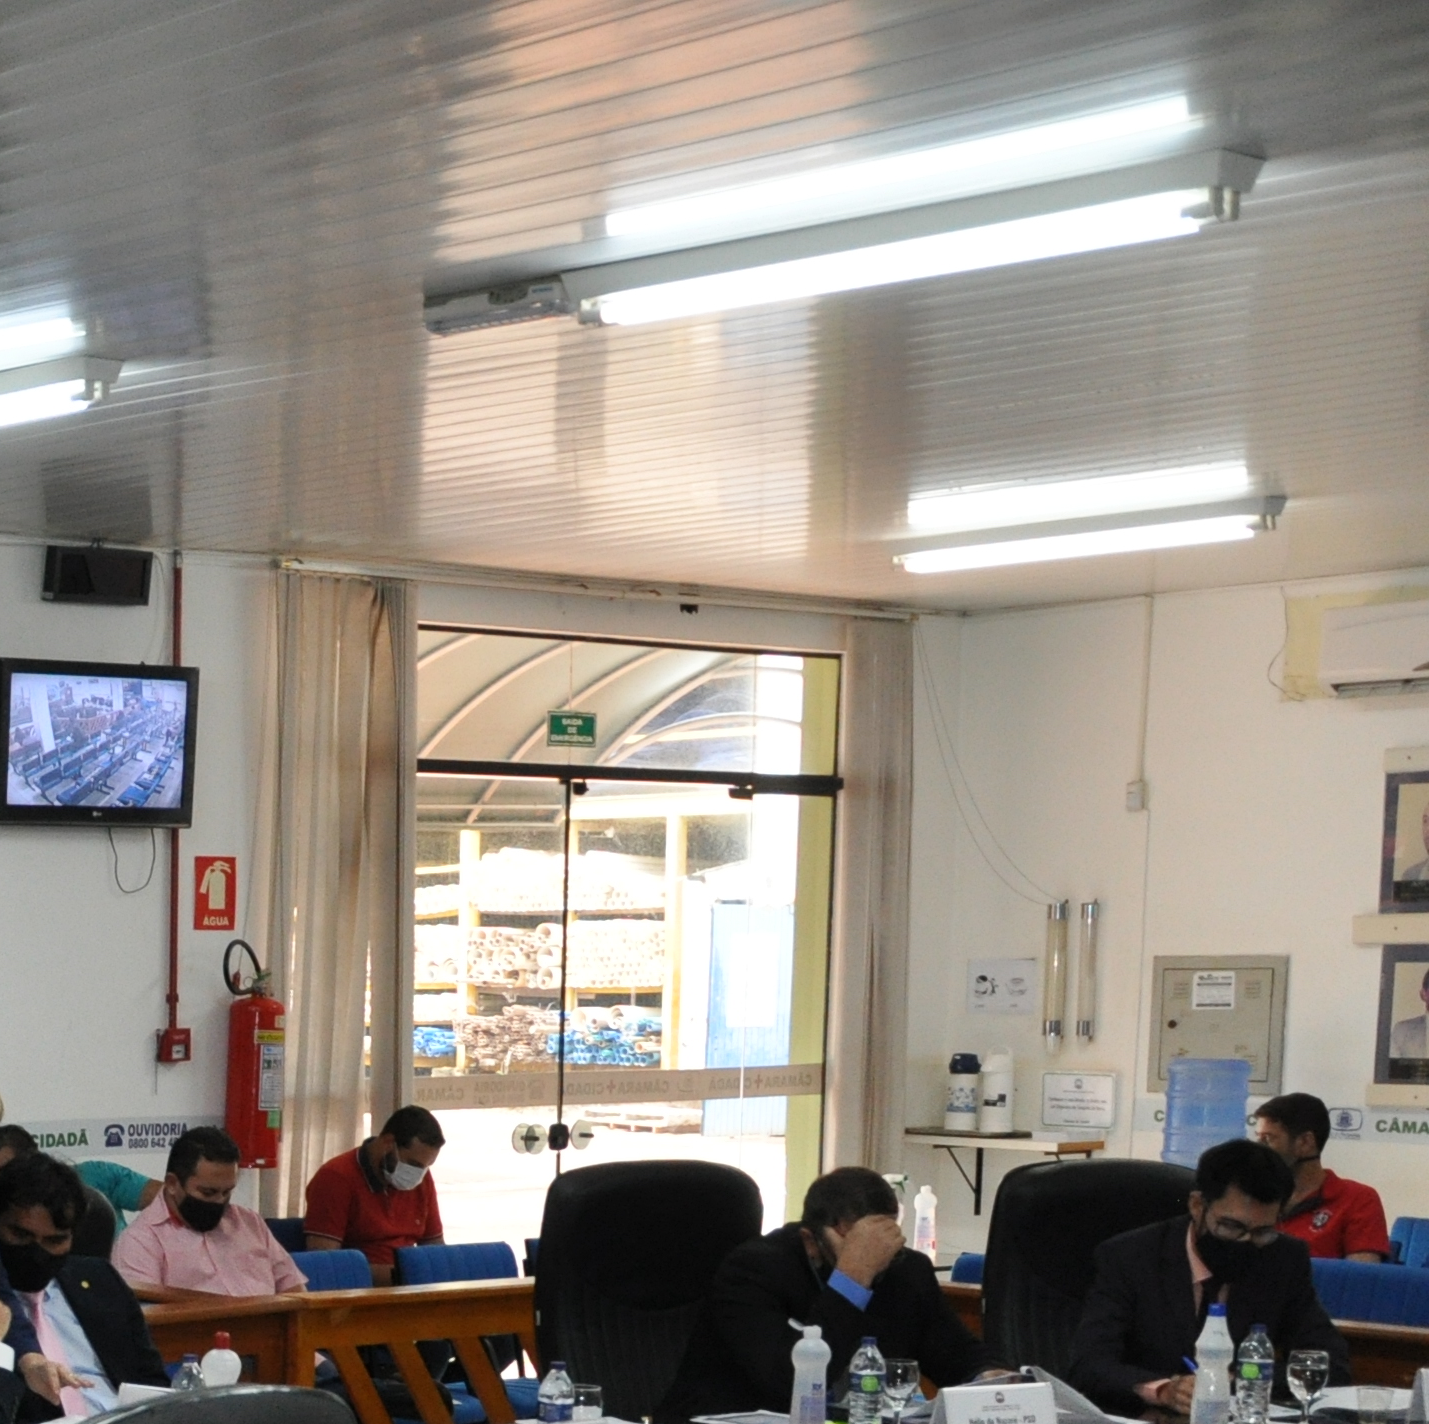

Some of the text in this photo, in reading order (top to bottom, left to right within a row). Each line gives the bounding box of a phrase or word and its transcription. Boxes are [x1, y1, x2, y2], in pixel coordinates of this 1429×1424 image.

[127, 1122, 188, 1137] OUVIDORIA
[128, 1137, 149, 1149] 0800
[151, 1136, 166, 1149] 642
